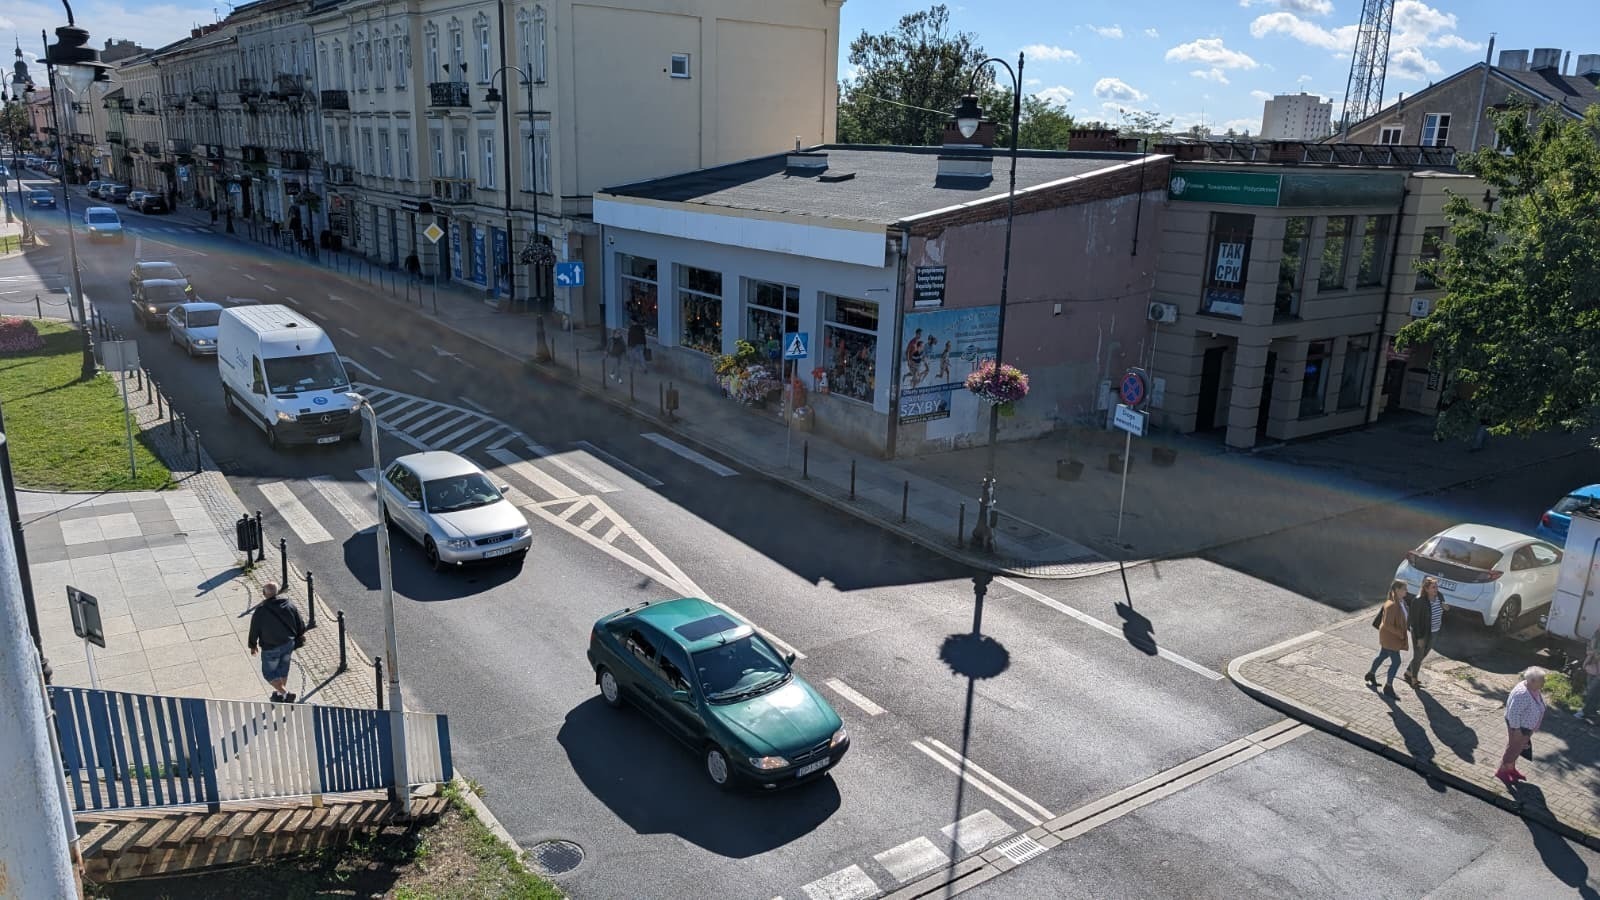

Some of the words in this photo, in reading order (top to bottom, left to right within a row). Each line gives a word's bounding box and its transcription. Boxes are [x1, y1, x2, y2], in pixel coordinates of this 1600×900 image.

[1221, 244, 1242, 259] TAK
[1216, 265, 1240, 280] CPK
[900, 400, 941, 416] SZYBY
